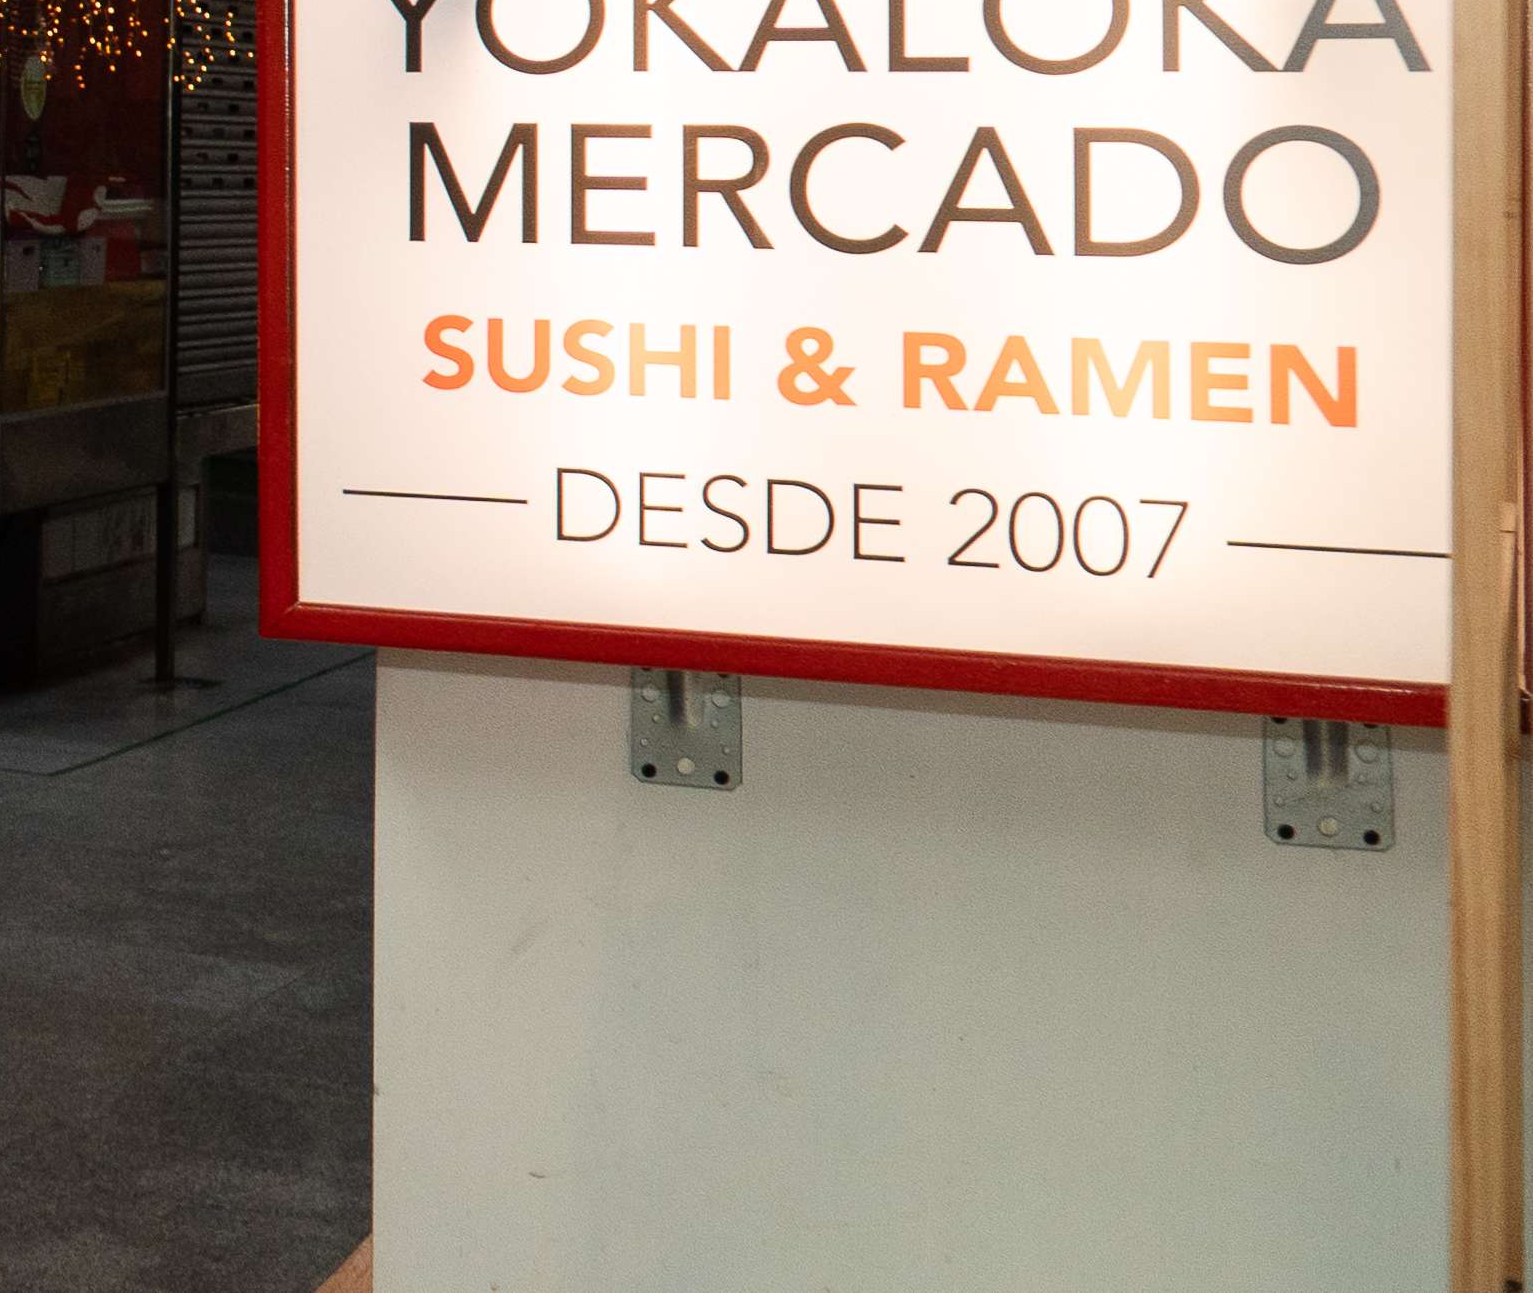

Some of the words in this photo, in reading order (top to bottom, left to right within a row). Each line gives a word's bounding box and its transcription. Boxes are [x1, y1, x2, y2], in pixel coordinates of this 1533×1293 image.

[407, 120, 1380, 265] MERCADO
[422, 315, 732, 401] SUSHI
[776, 326, 858, 408] &
[902, 332, 1358, 429] RAMEN
[556, 467, 905, 563] DESDE
[946, 489, 1191, 579] 2007
